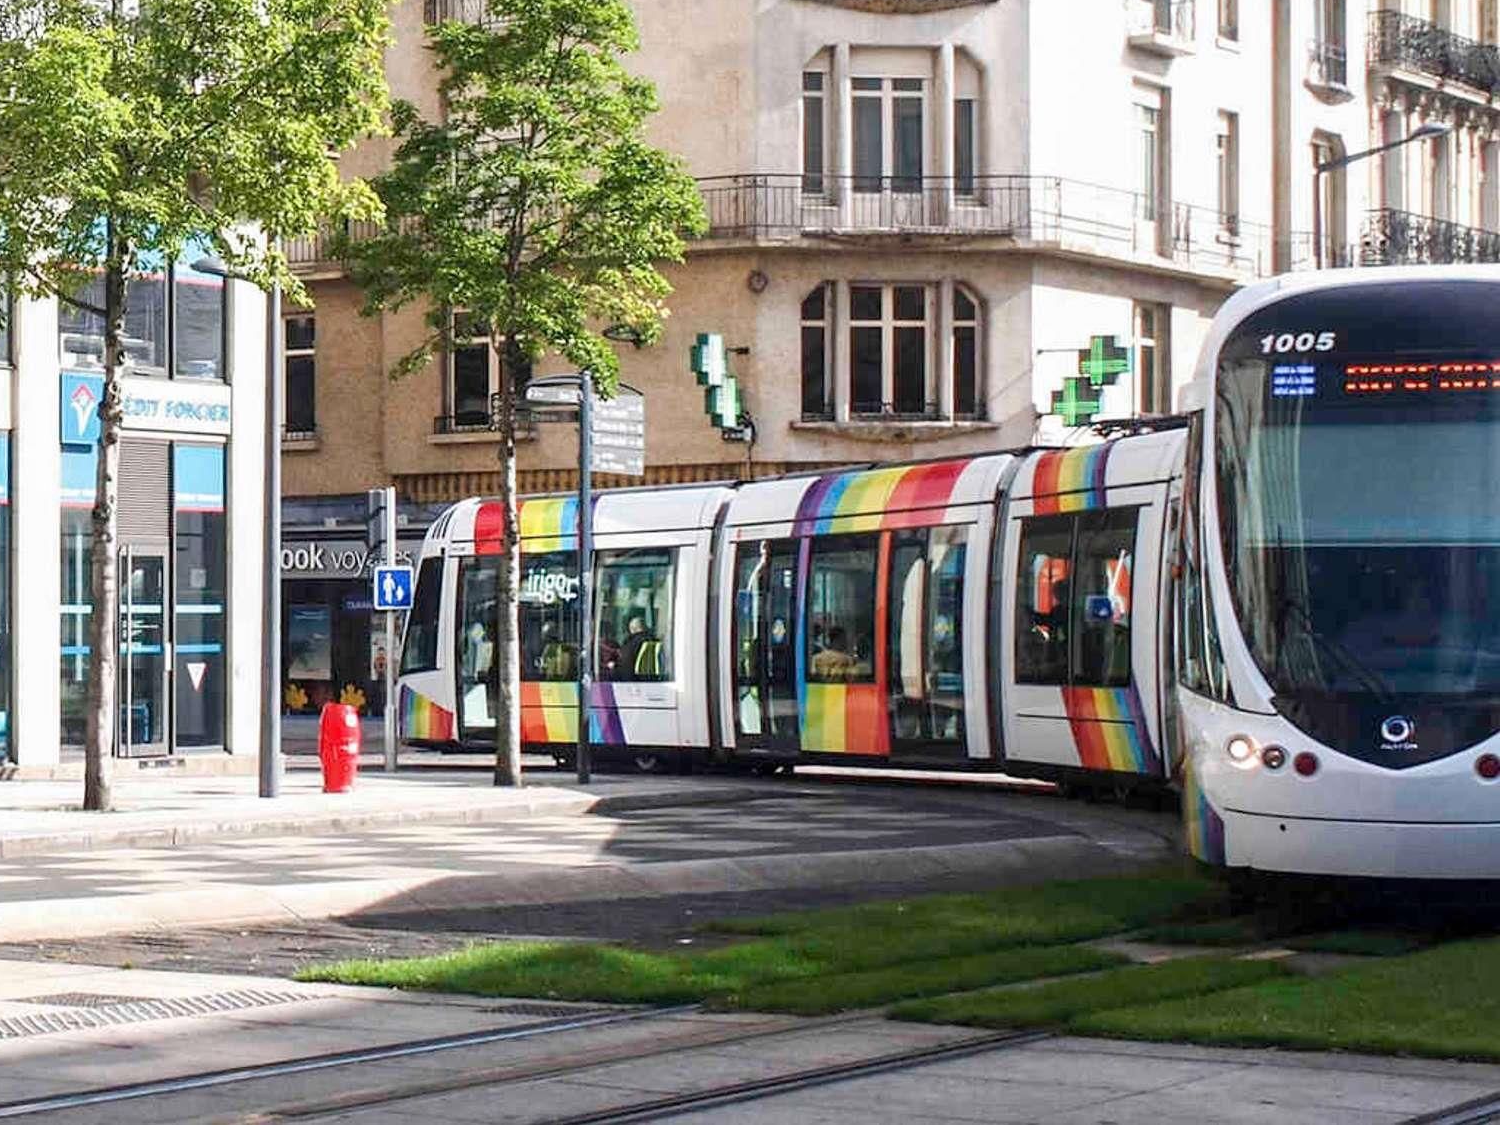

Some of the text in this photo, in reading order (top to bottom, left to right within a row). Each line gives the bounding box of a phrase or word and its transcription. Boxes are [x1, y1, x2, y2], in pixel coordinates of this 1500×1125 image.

[1261, 331, 1336, 353] 1005
[281, 542, 412, 578] ook voyes
